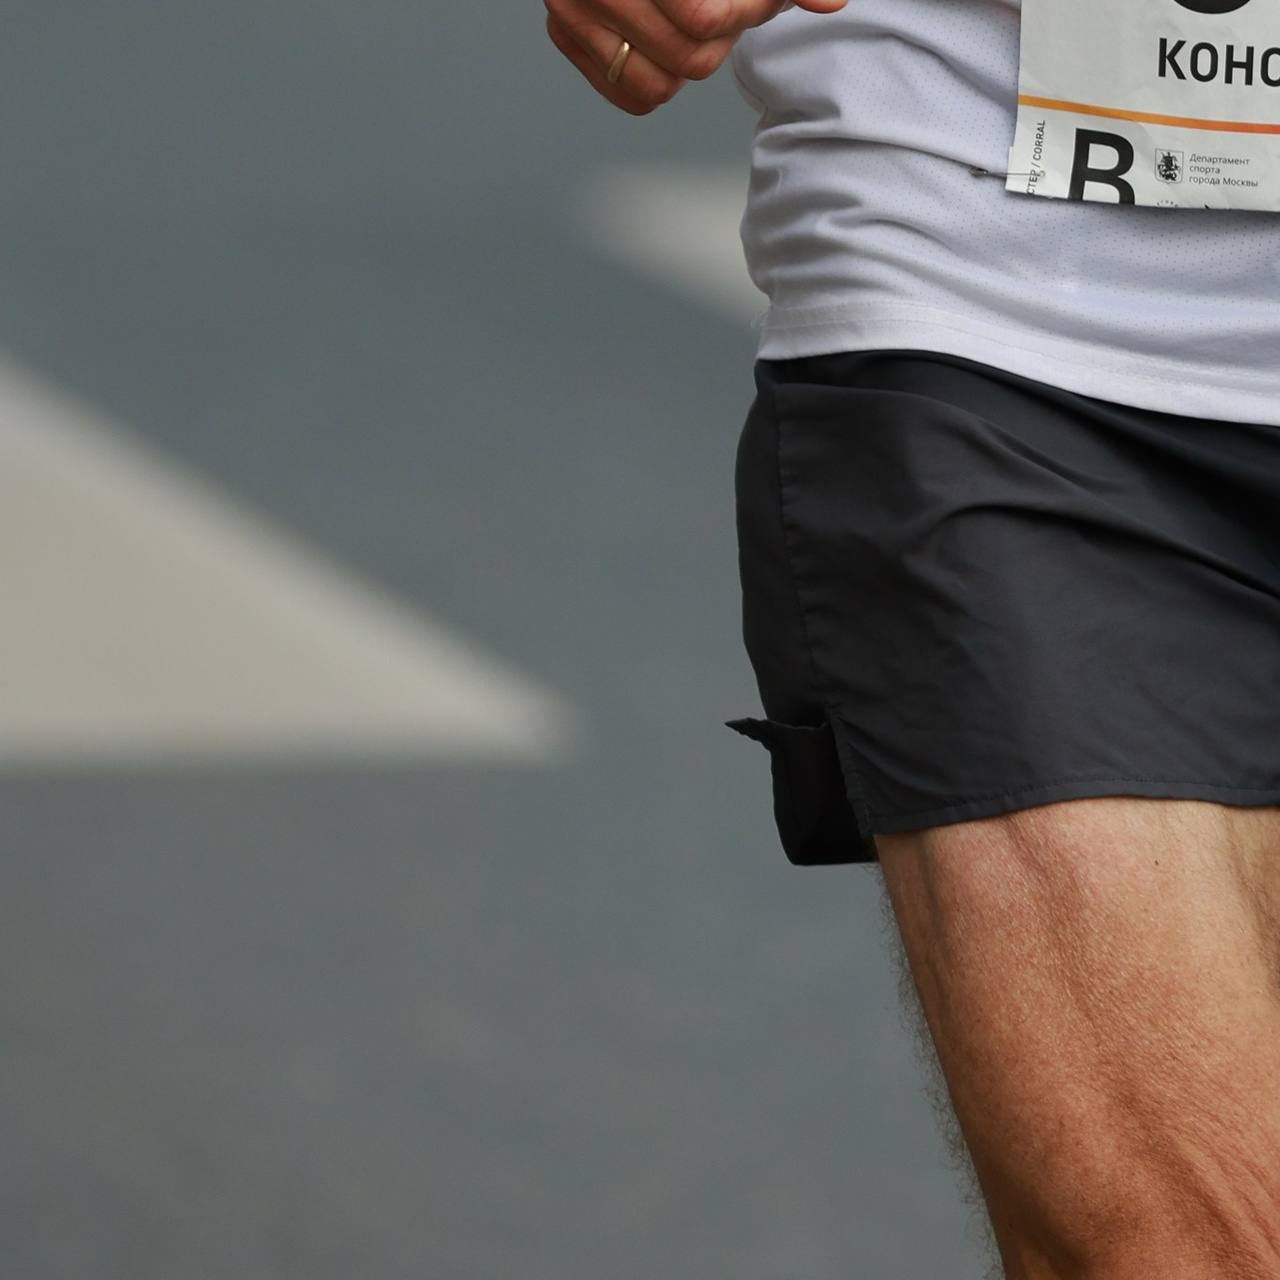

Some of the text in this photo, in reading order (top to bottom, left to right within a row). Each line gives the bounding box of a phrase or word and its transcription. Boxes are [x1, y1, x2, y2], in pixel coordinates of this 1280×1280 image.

[1032, 120, 1046, 161] CORRAL
[1189, 153, 1250, 166] Департамент
[1189, 165, 1221, 175] спорта
[1188, 175, 1259, 188] города Москвы
